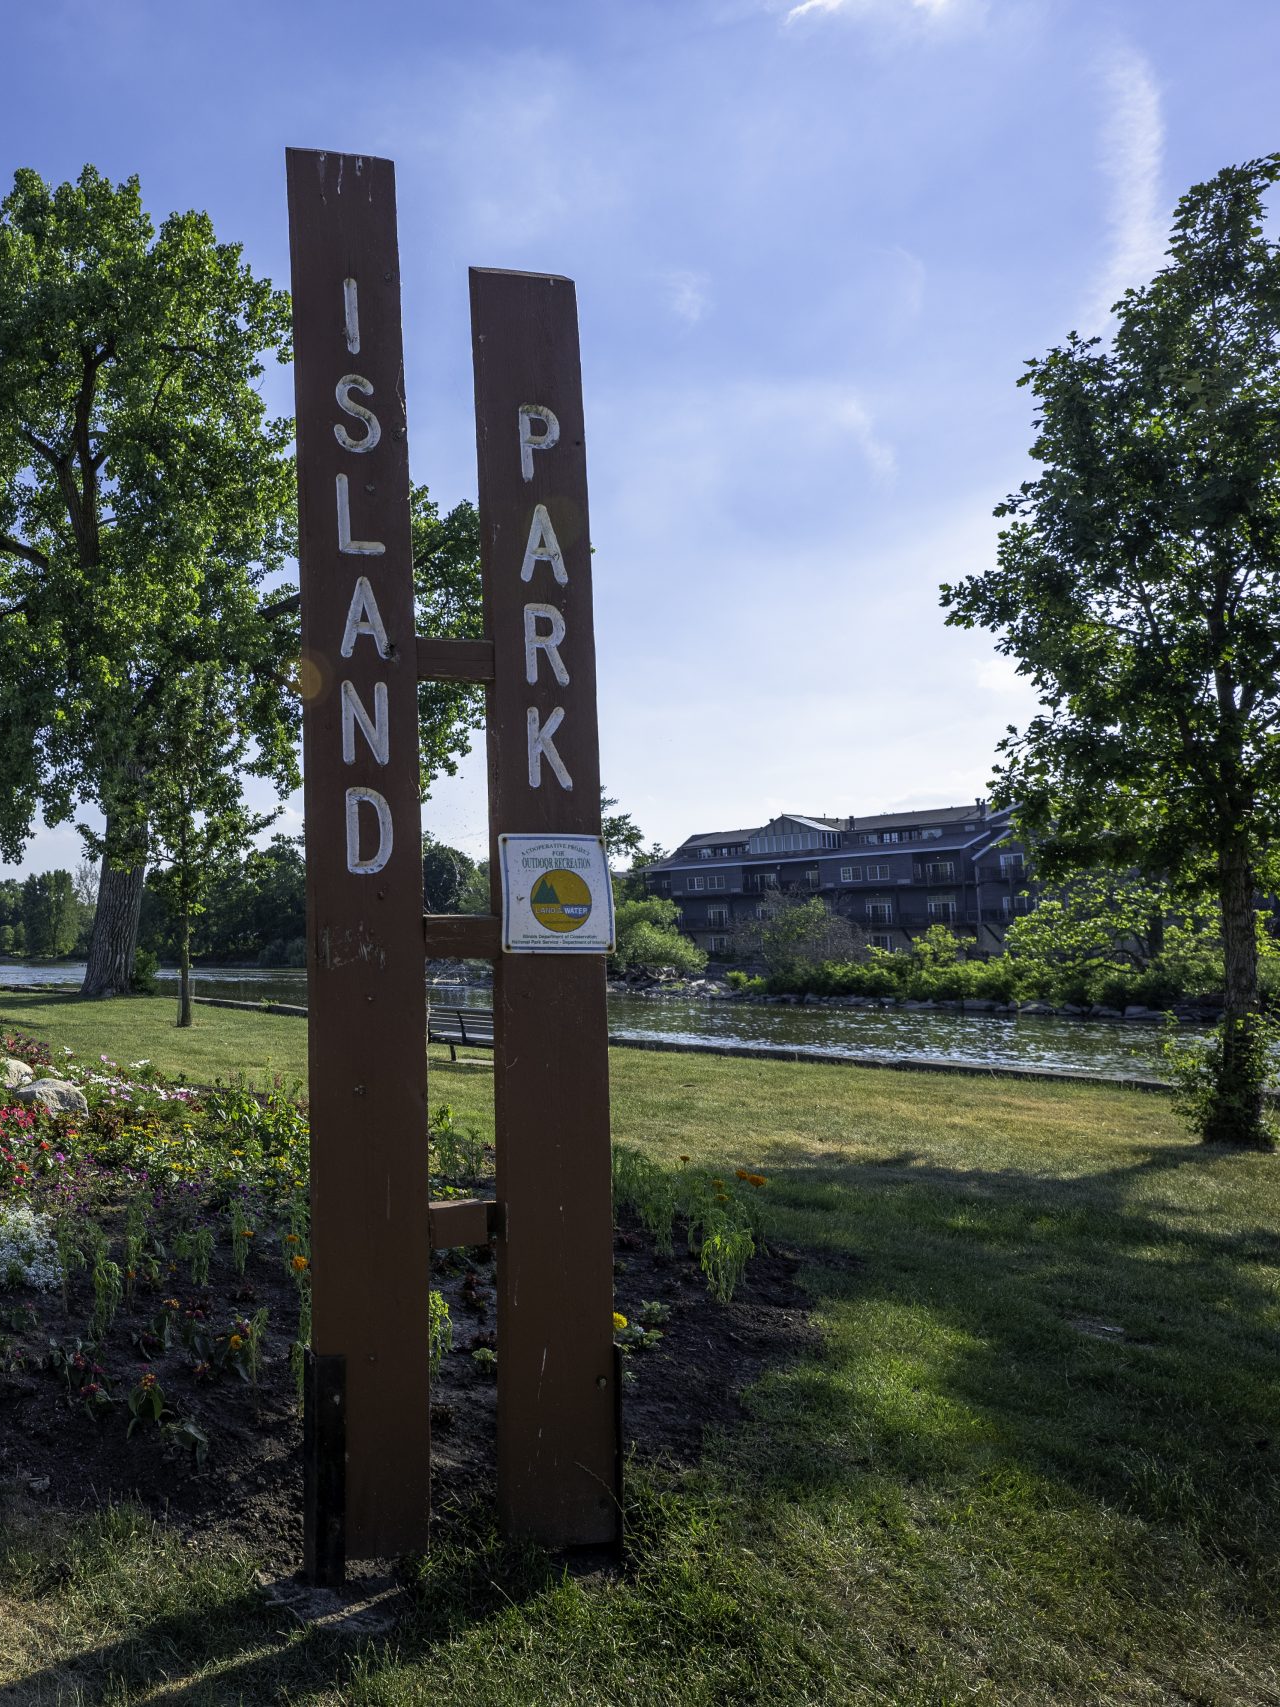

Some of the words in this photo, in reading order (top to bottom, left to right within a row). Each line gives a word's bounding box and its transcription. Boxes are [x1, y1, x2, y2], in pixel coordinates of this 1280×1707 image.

[333, 277, 394, 875] ISLAND
[516, 403, 574, 792] PARK
[522, 857, 553, 869] OUTDOOR
[554, 857, 591, 869] RECREATION
[526, 843, 567, 855] COOPERATIVE
[567, 844, 590, 856] PROJECT
